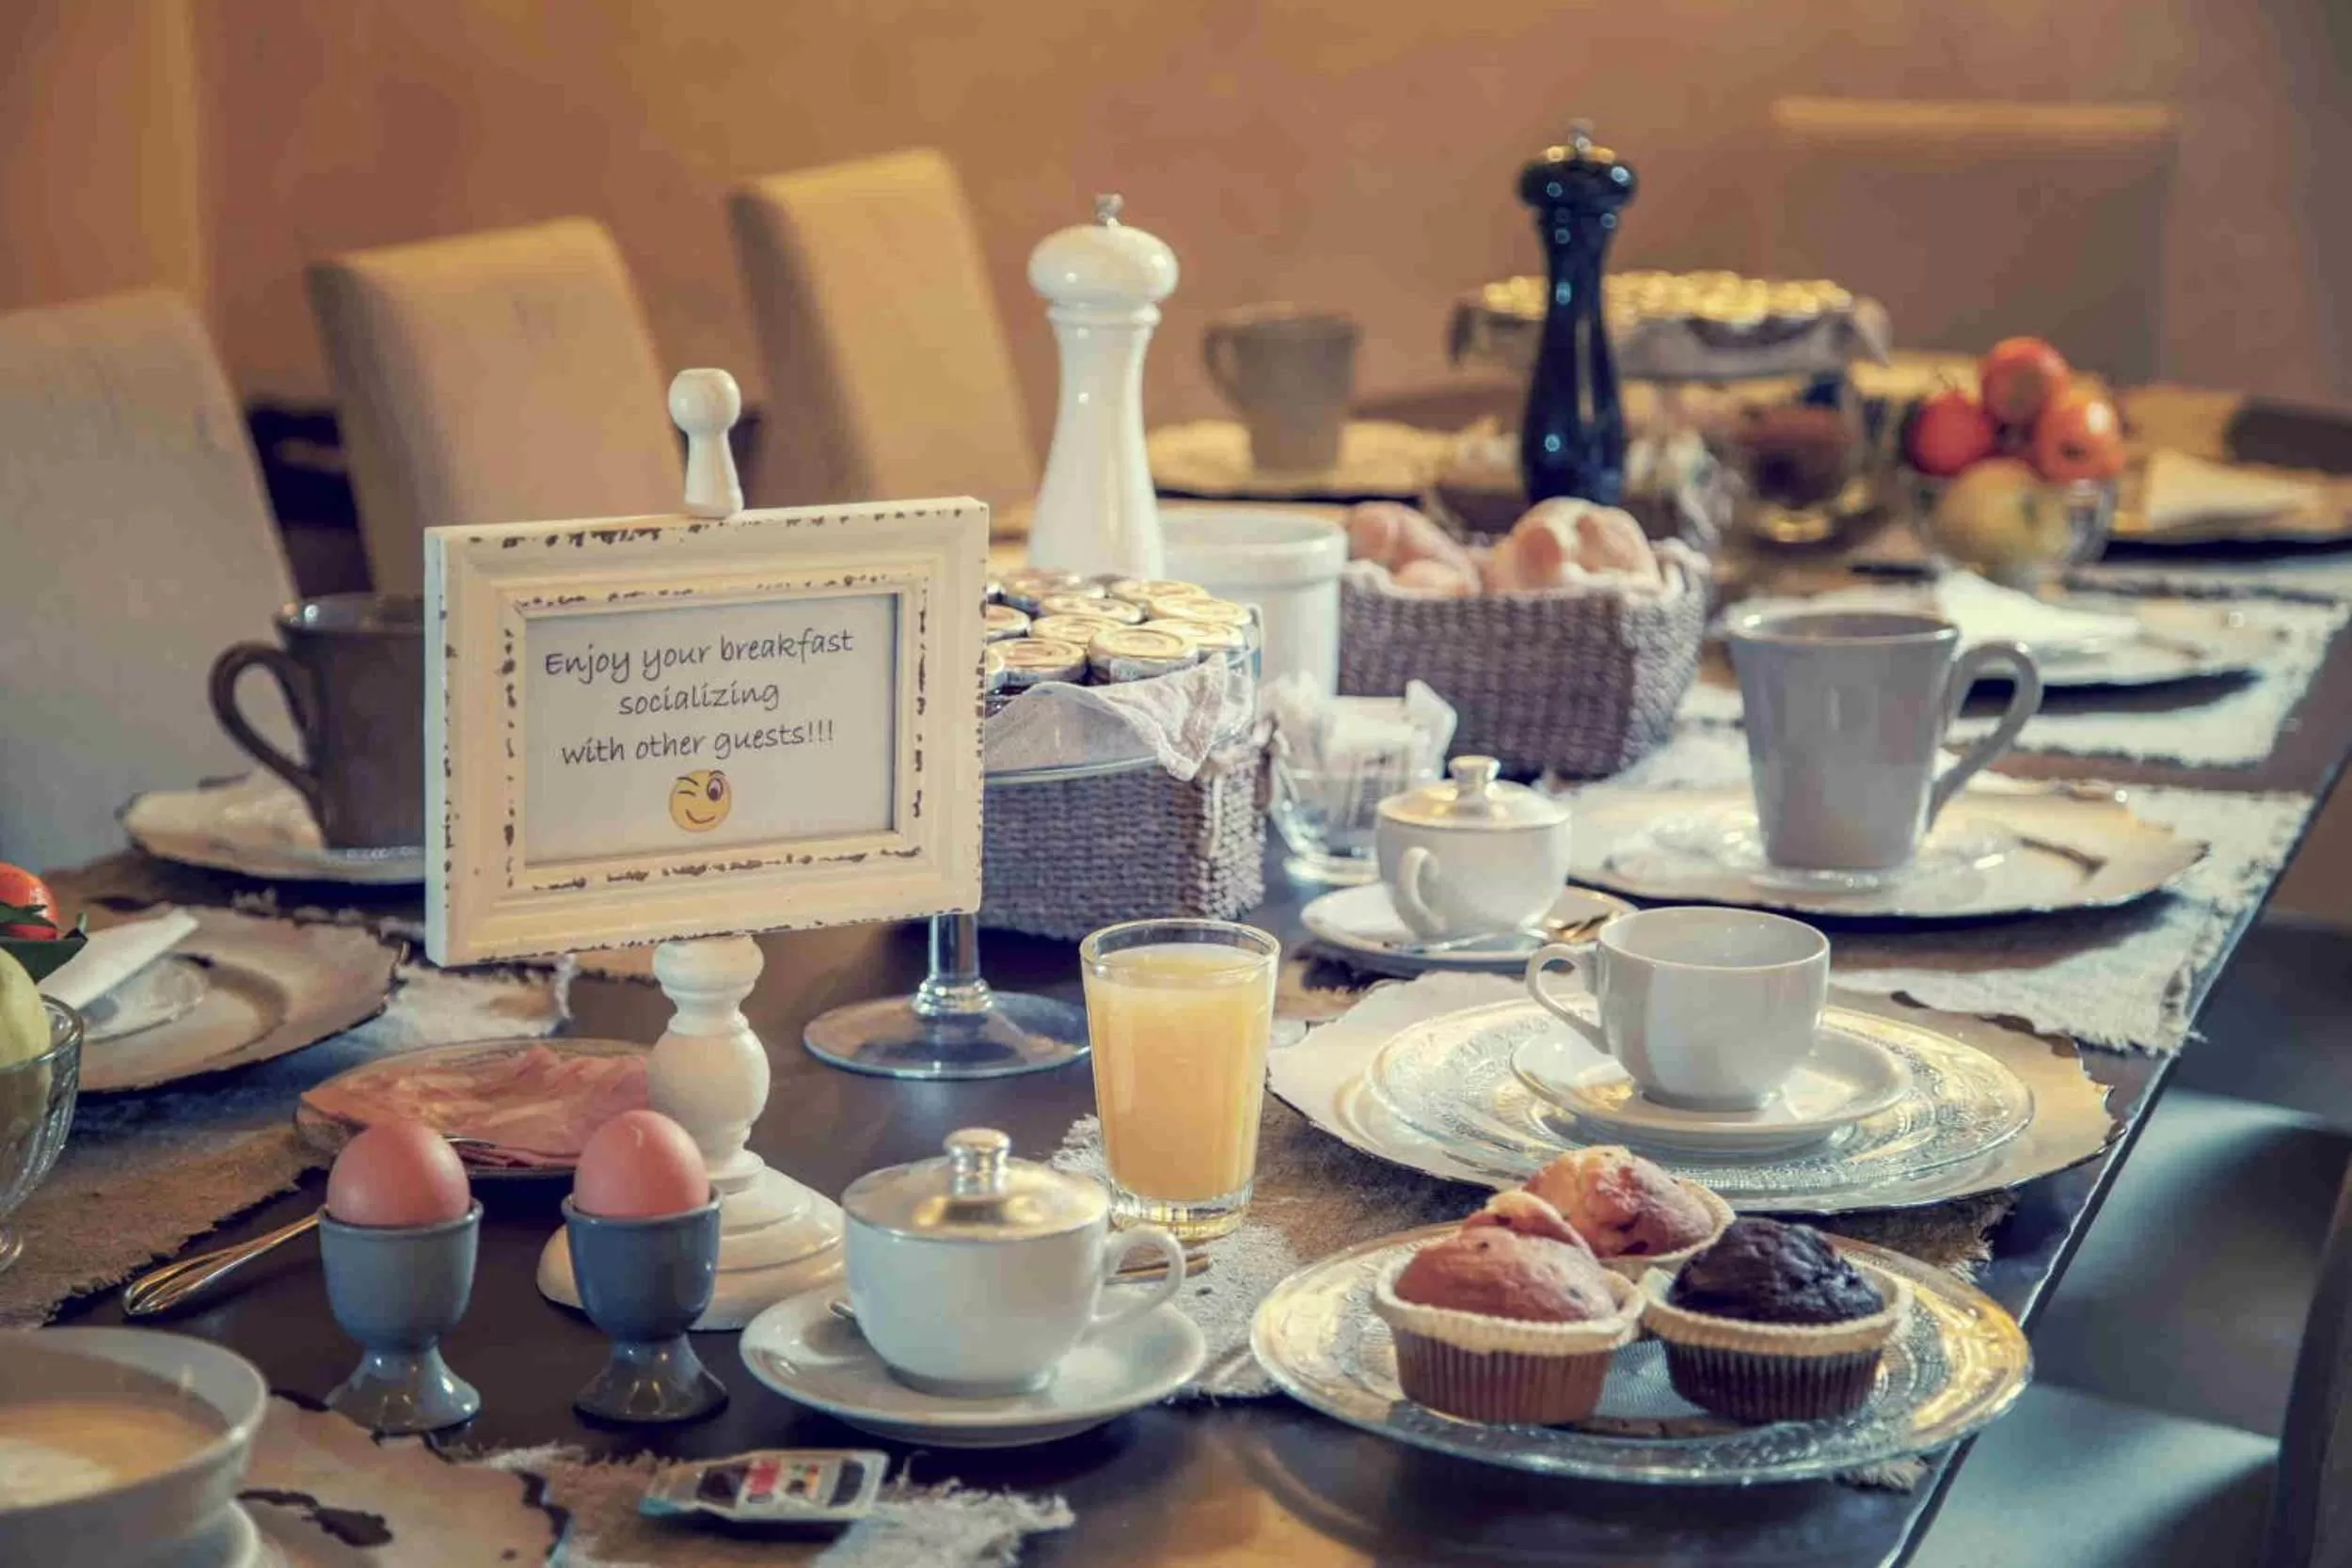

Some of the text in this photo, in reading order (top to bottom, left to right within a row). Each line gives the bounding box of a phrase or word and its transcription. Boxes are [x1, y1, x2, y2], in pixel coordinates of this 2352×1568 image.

[545, 628, 855, 684] Enjoy your breakfast
[618, 680, 780, 716] socializing
[562, 720, 834, 765] with other guests!!!
